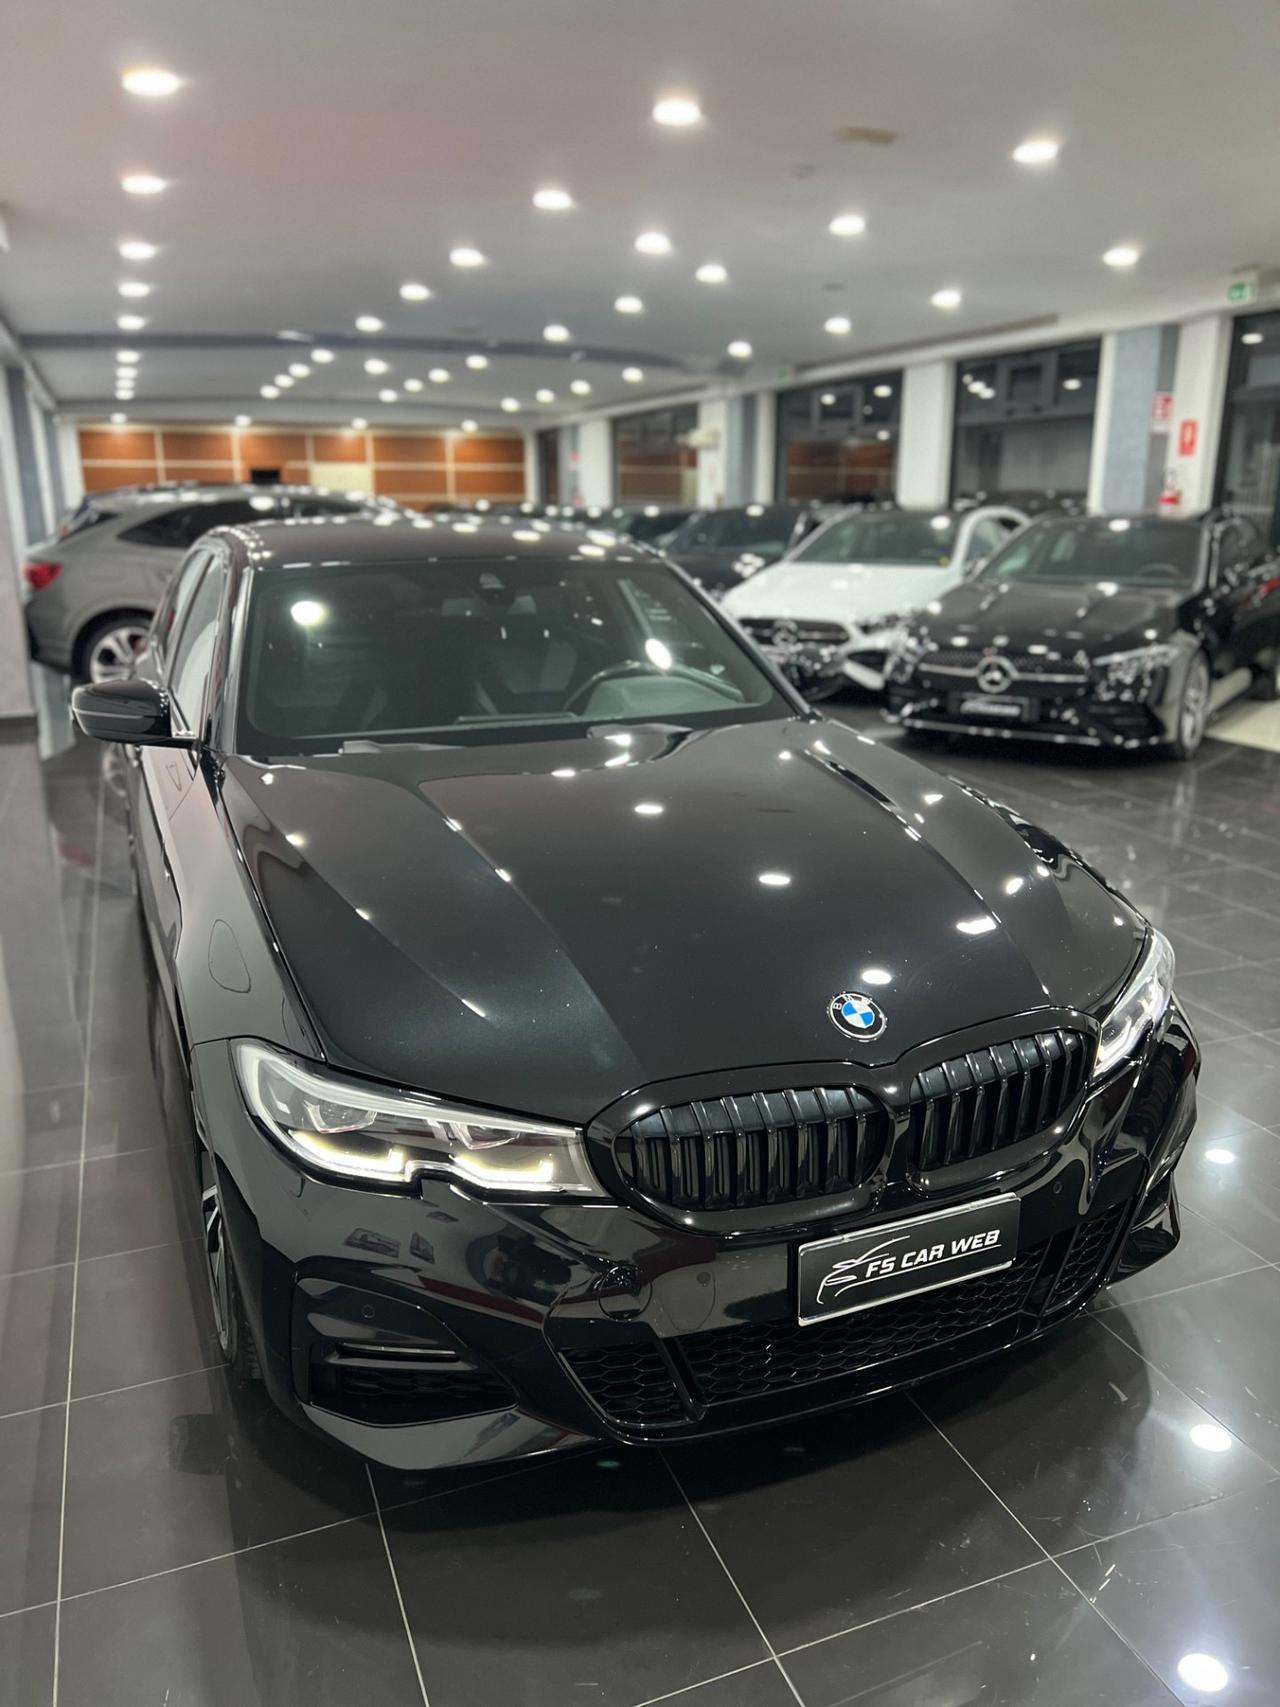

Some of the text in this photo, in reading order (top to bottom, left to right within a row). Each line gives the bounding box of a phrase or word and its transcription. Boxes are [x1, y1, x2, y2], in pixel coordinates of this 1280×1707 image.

[866, 1229, 1000, 1278] FS CAR WEB
